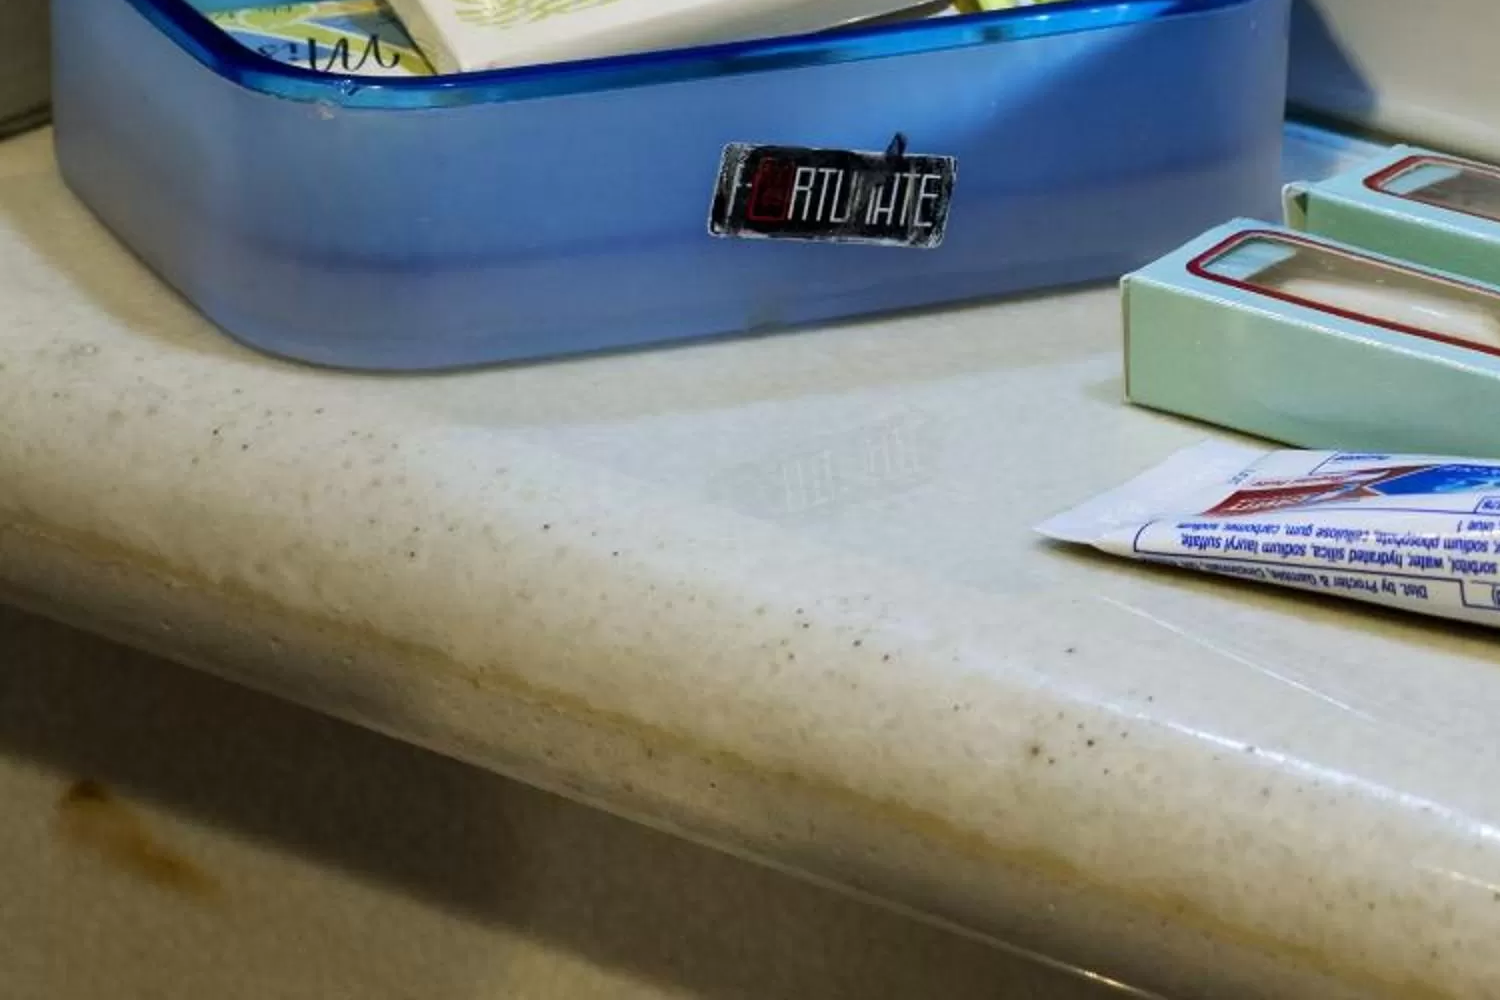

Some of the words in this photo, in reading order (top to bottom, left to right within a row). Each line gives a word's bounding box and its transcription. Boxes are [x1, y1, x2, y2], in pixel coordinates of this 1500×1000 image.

[1224, 535, 1257, 554] lauryl
[1262, 541, 1306, 558] sodium
[1444, 538, 1488, 554] sodium
[1348, 548, 1402, 568] hydrated
[1381, 578, 1396, 595] by
[1399, 583, 1427, 599] Dist.
